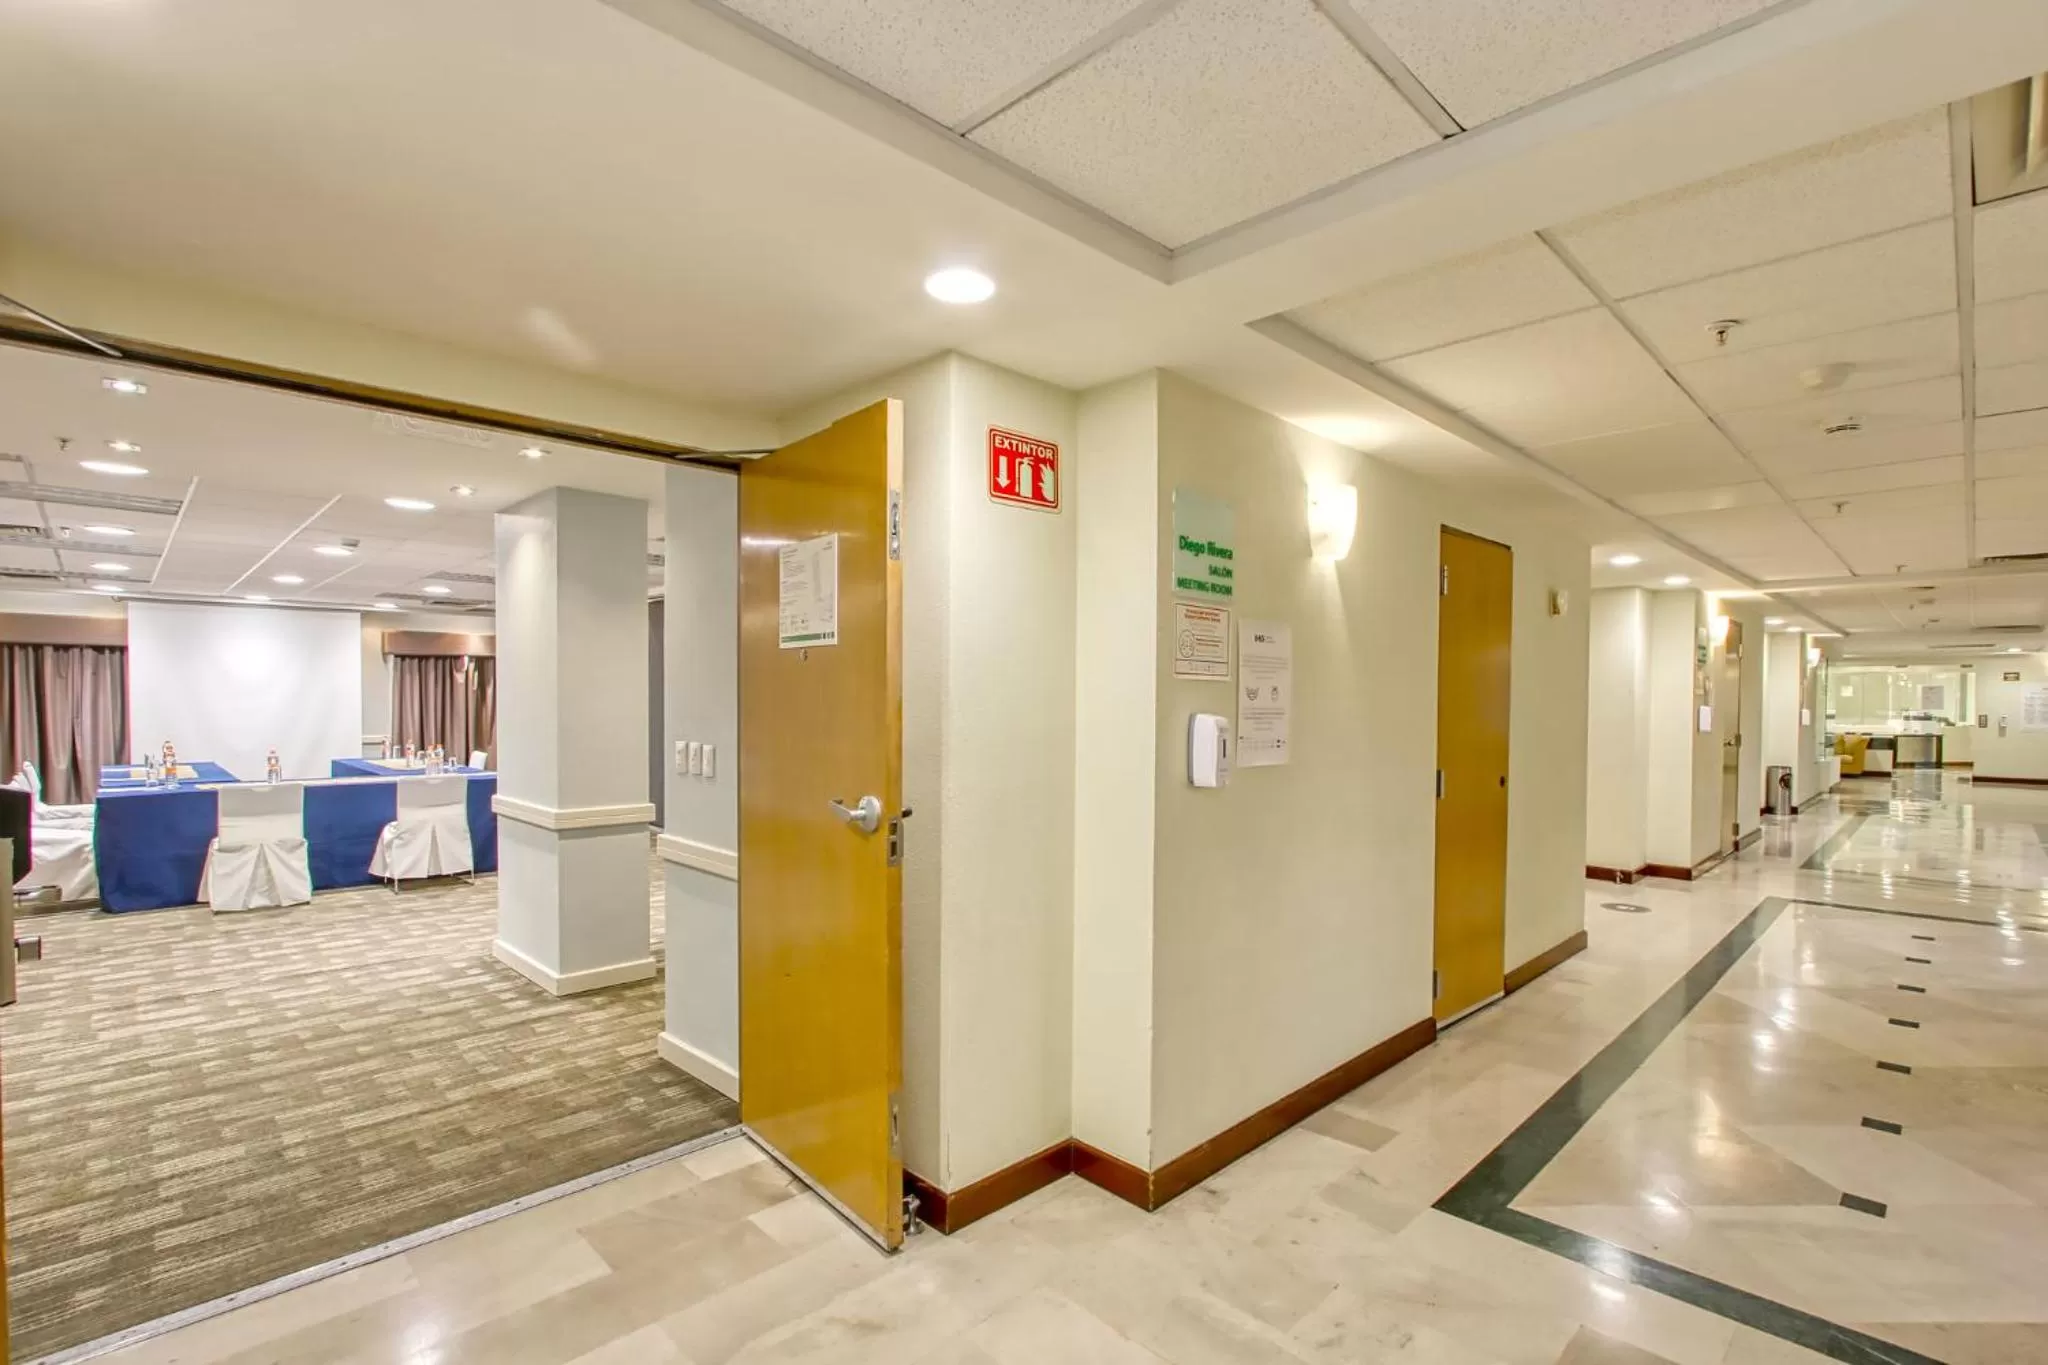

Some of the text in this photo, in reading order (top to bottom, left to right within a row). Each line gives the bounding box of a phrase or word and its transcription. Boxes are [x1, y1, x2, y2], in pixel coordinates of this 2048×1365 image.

[994, 435, 1054, 460] EXTINTOR
[1179, 535, 1233, 560] Diego Rivera
[1176, 577, 1233, 597] MEETING ROOM
